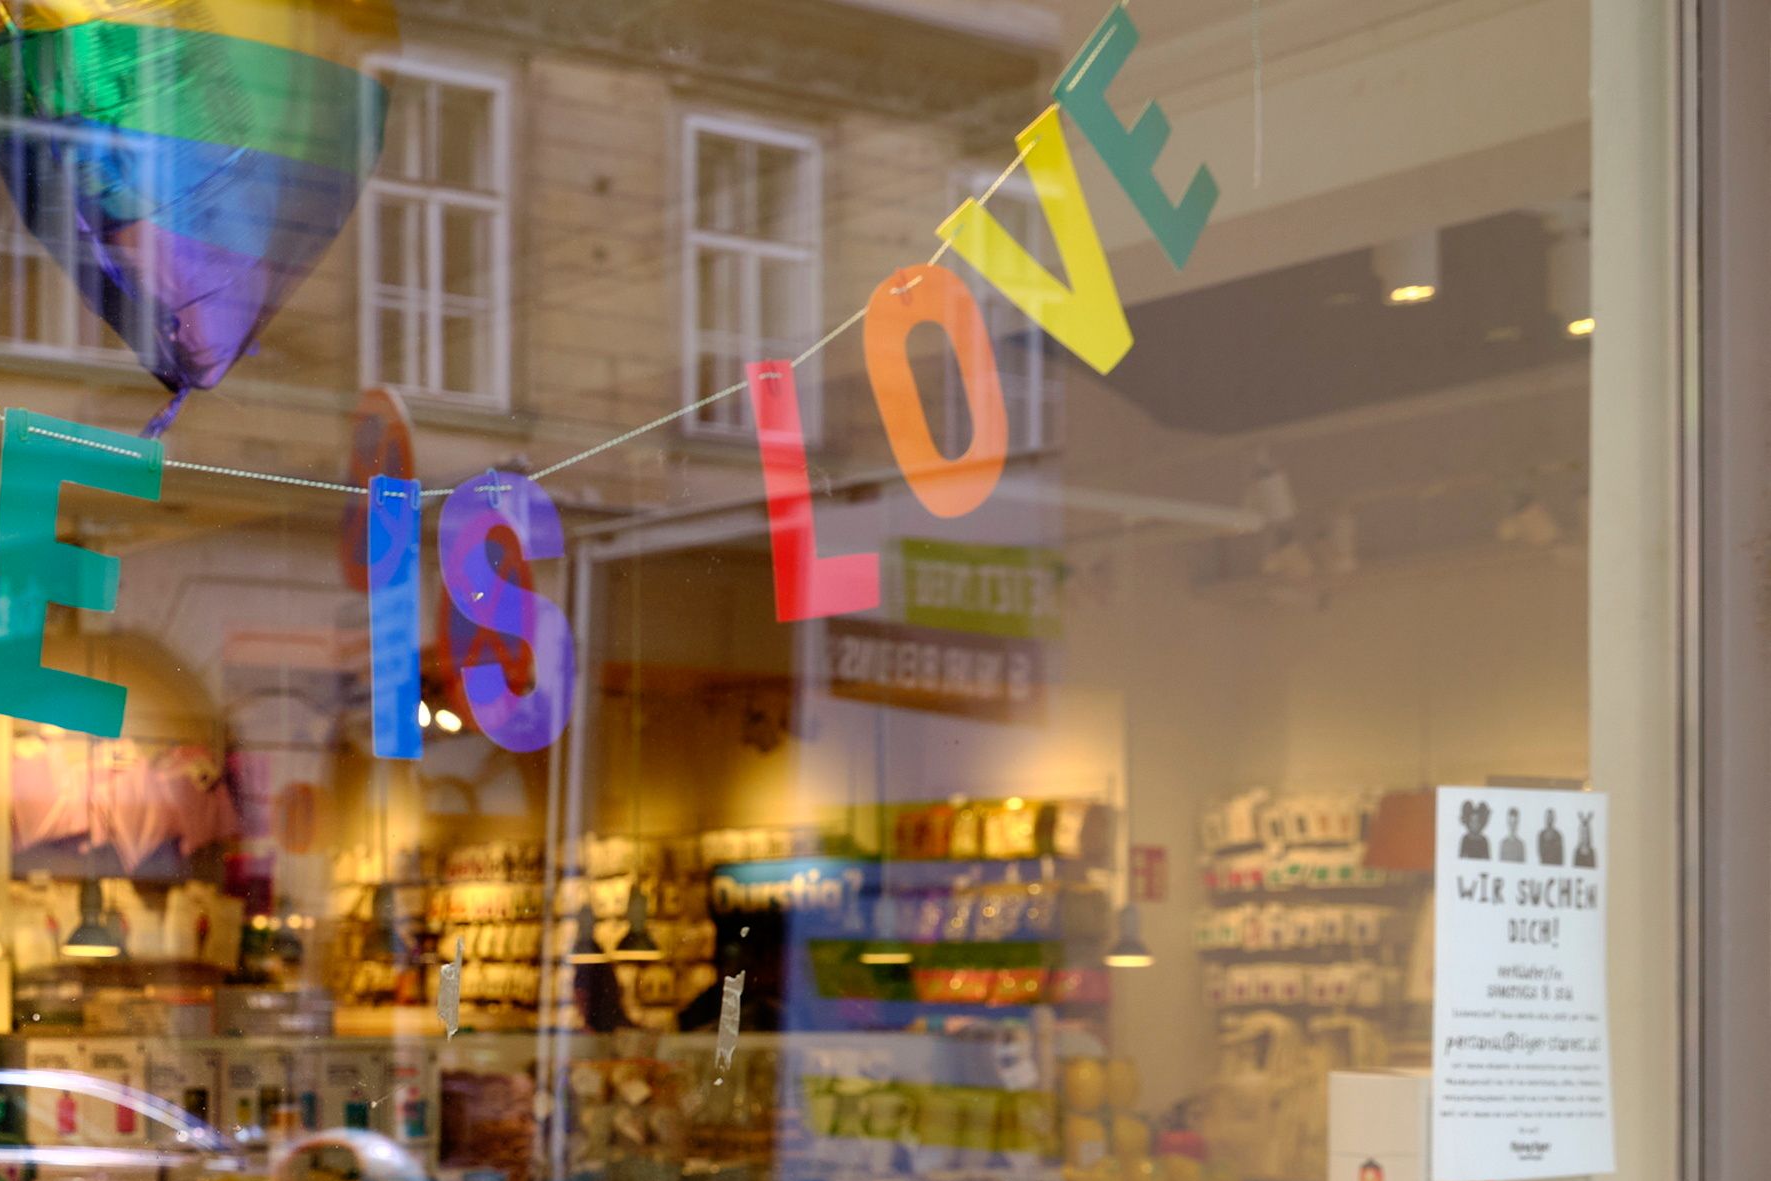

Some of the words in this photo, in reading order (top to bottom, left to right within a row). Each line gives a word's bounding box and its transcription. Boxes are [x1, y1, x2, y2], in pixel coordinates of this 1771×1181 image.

[368, 471, 576, 760] IS
[746, 2, 1219, 622] LOVE
[1457, 872, 1505, 905] WIR
[1516, 877, 1598, 910] SUCHEN
[1508, 917, 1560, 948] DICH!
